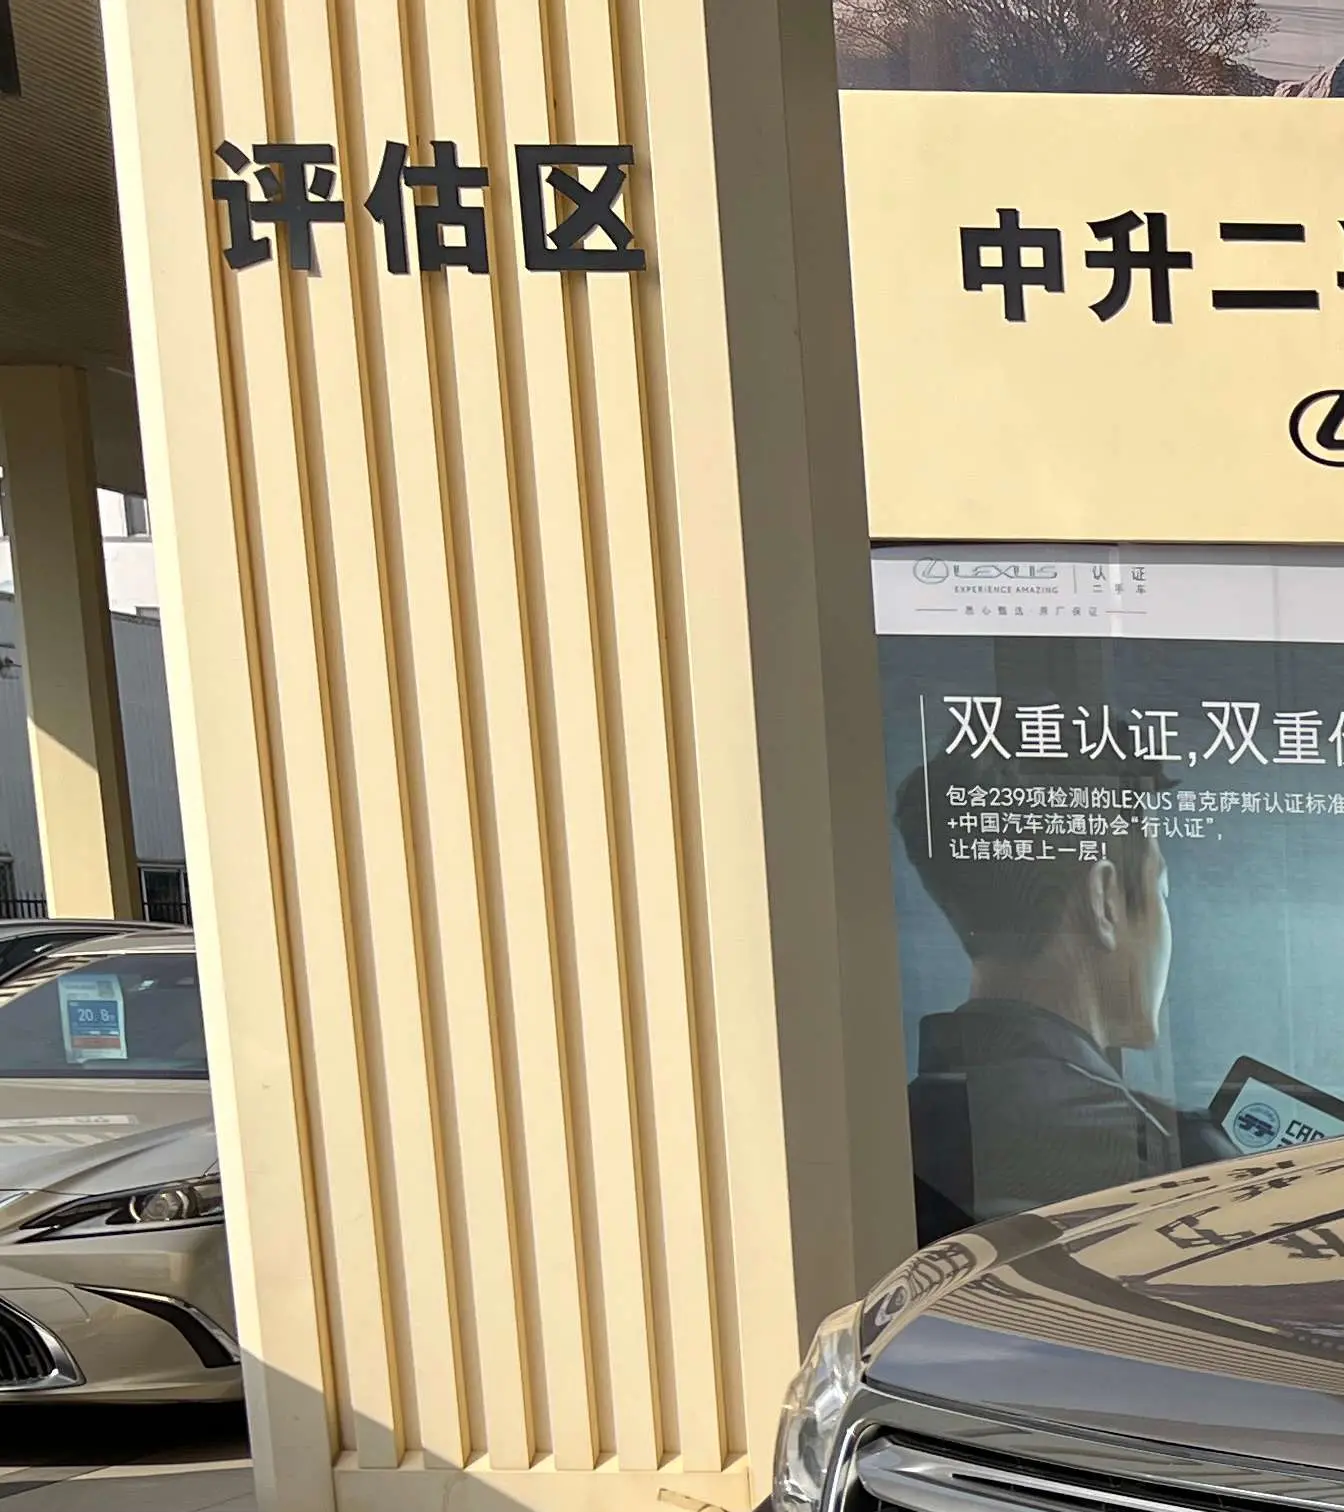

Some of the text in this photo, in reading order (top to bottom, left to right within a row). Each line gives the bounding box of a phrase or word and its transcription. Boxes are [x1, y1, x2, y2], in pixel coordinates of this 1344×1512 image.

[211, 139, 647, 275] 评估区
[953, 564, 1058, 580] LEXUS
[1092, 565, 1146, 582] 认证
[954, 585, 1059, 595] EXPERIENCE AMAZING
[1092, 583, 1146, 595] 二手车
[946, 784, 1172, 811] 包含239项检测的LEXUS
